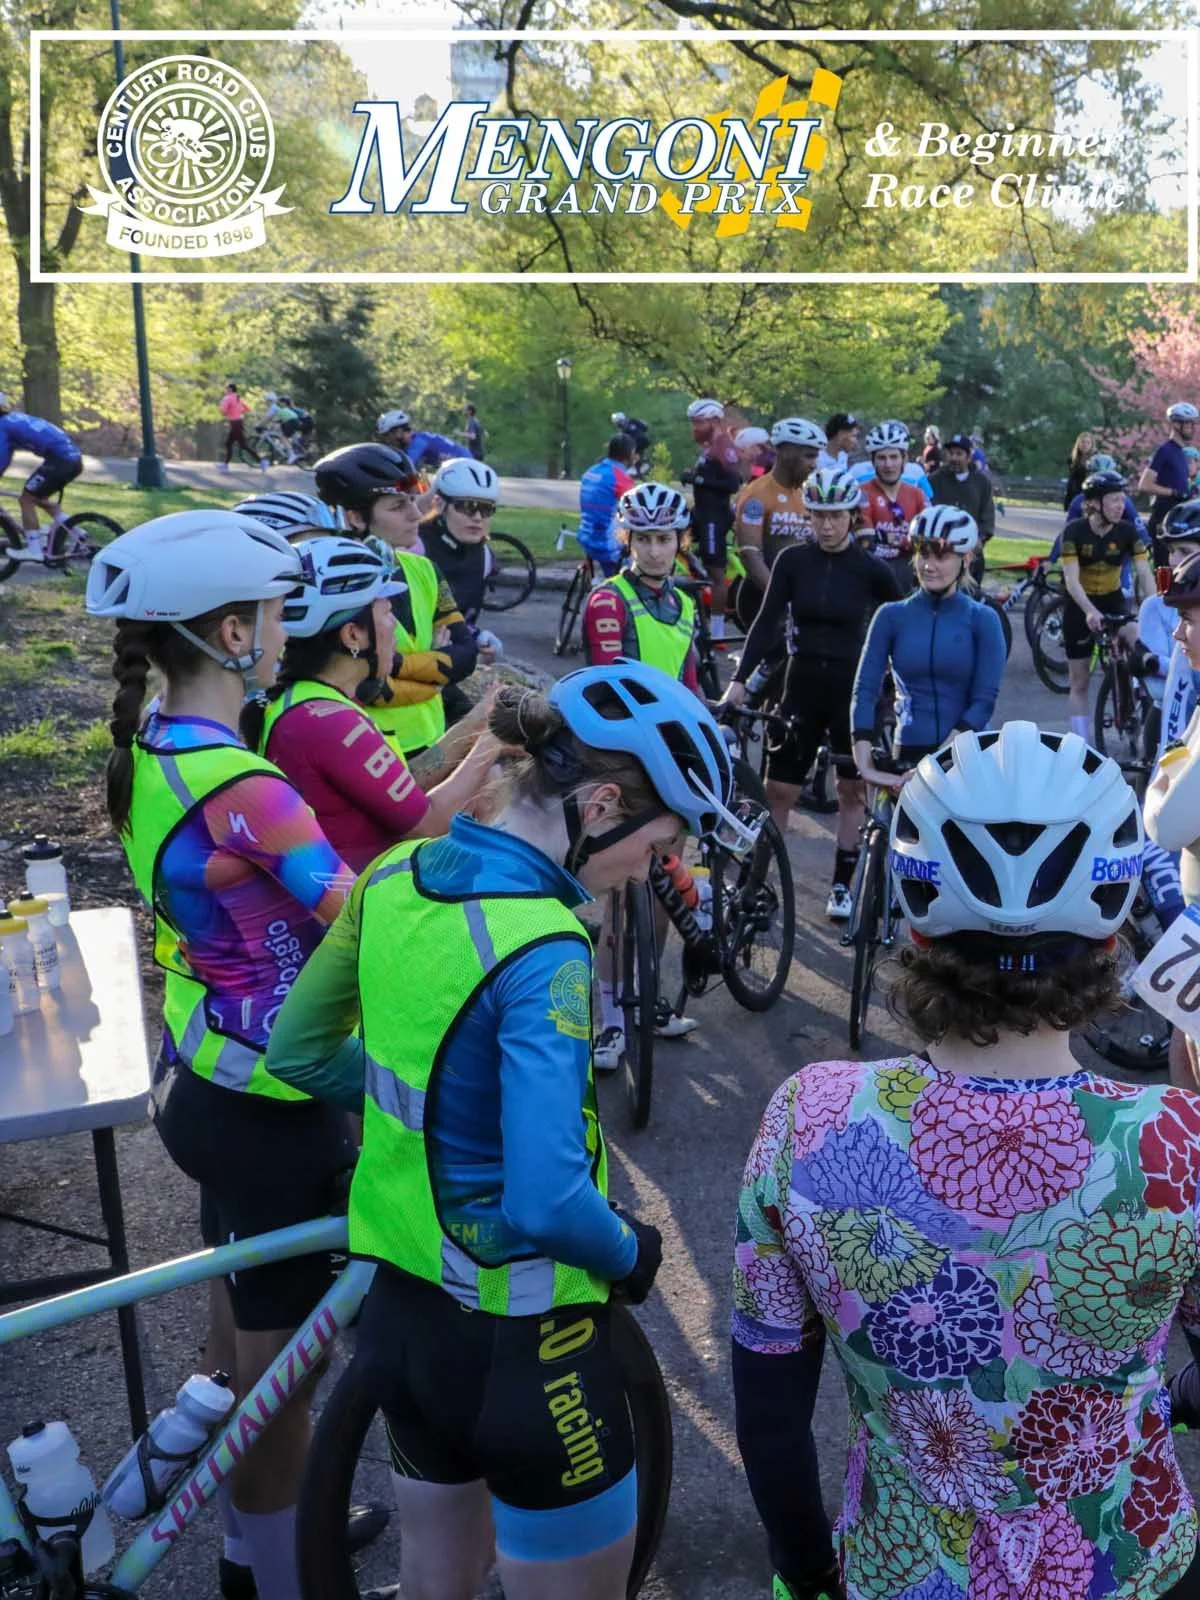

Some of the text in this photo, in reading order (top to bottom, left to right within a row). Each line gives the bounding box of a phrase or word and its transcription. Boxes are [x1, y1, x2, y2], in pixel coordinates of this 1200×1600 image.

[1167, 678, 1189, 742] REK
[150, 1305, 338, 1544] SPECIALIZED
[543, 1371, 606, 1488] racing
